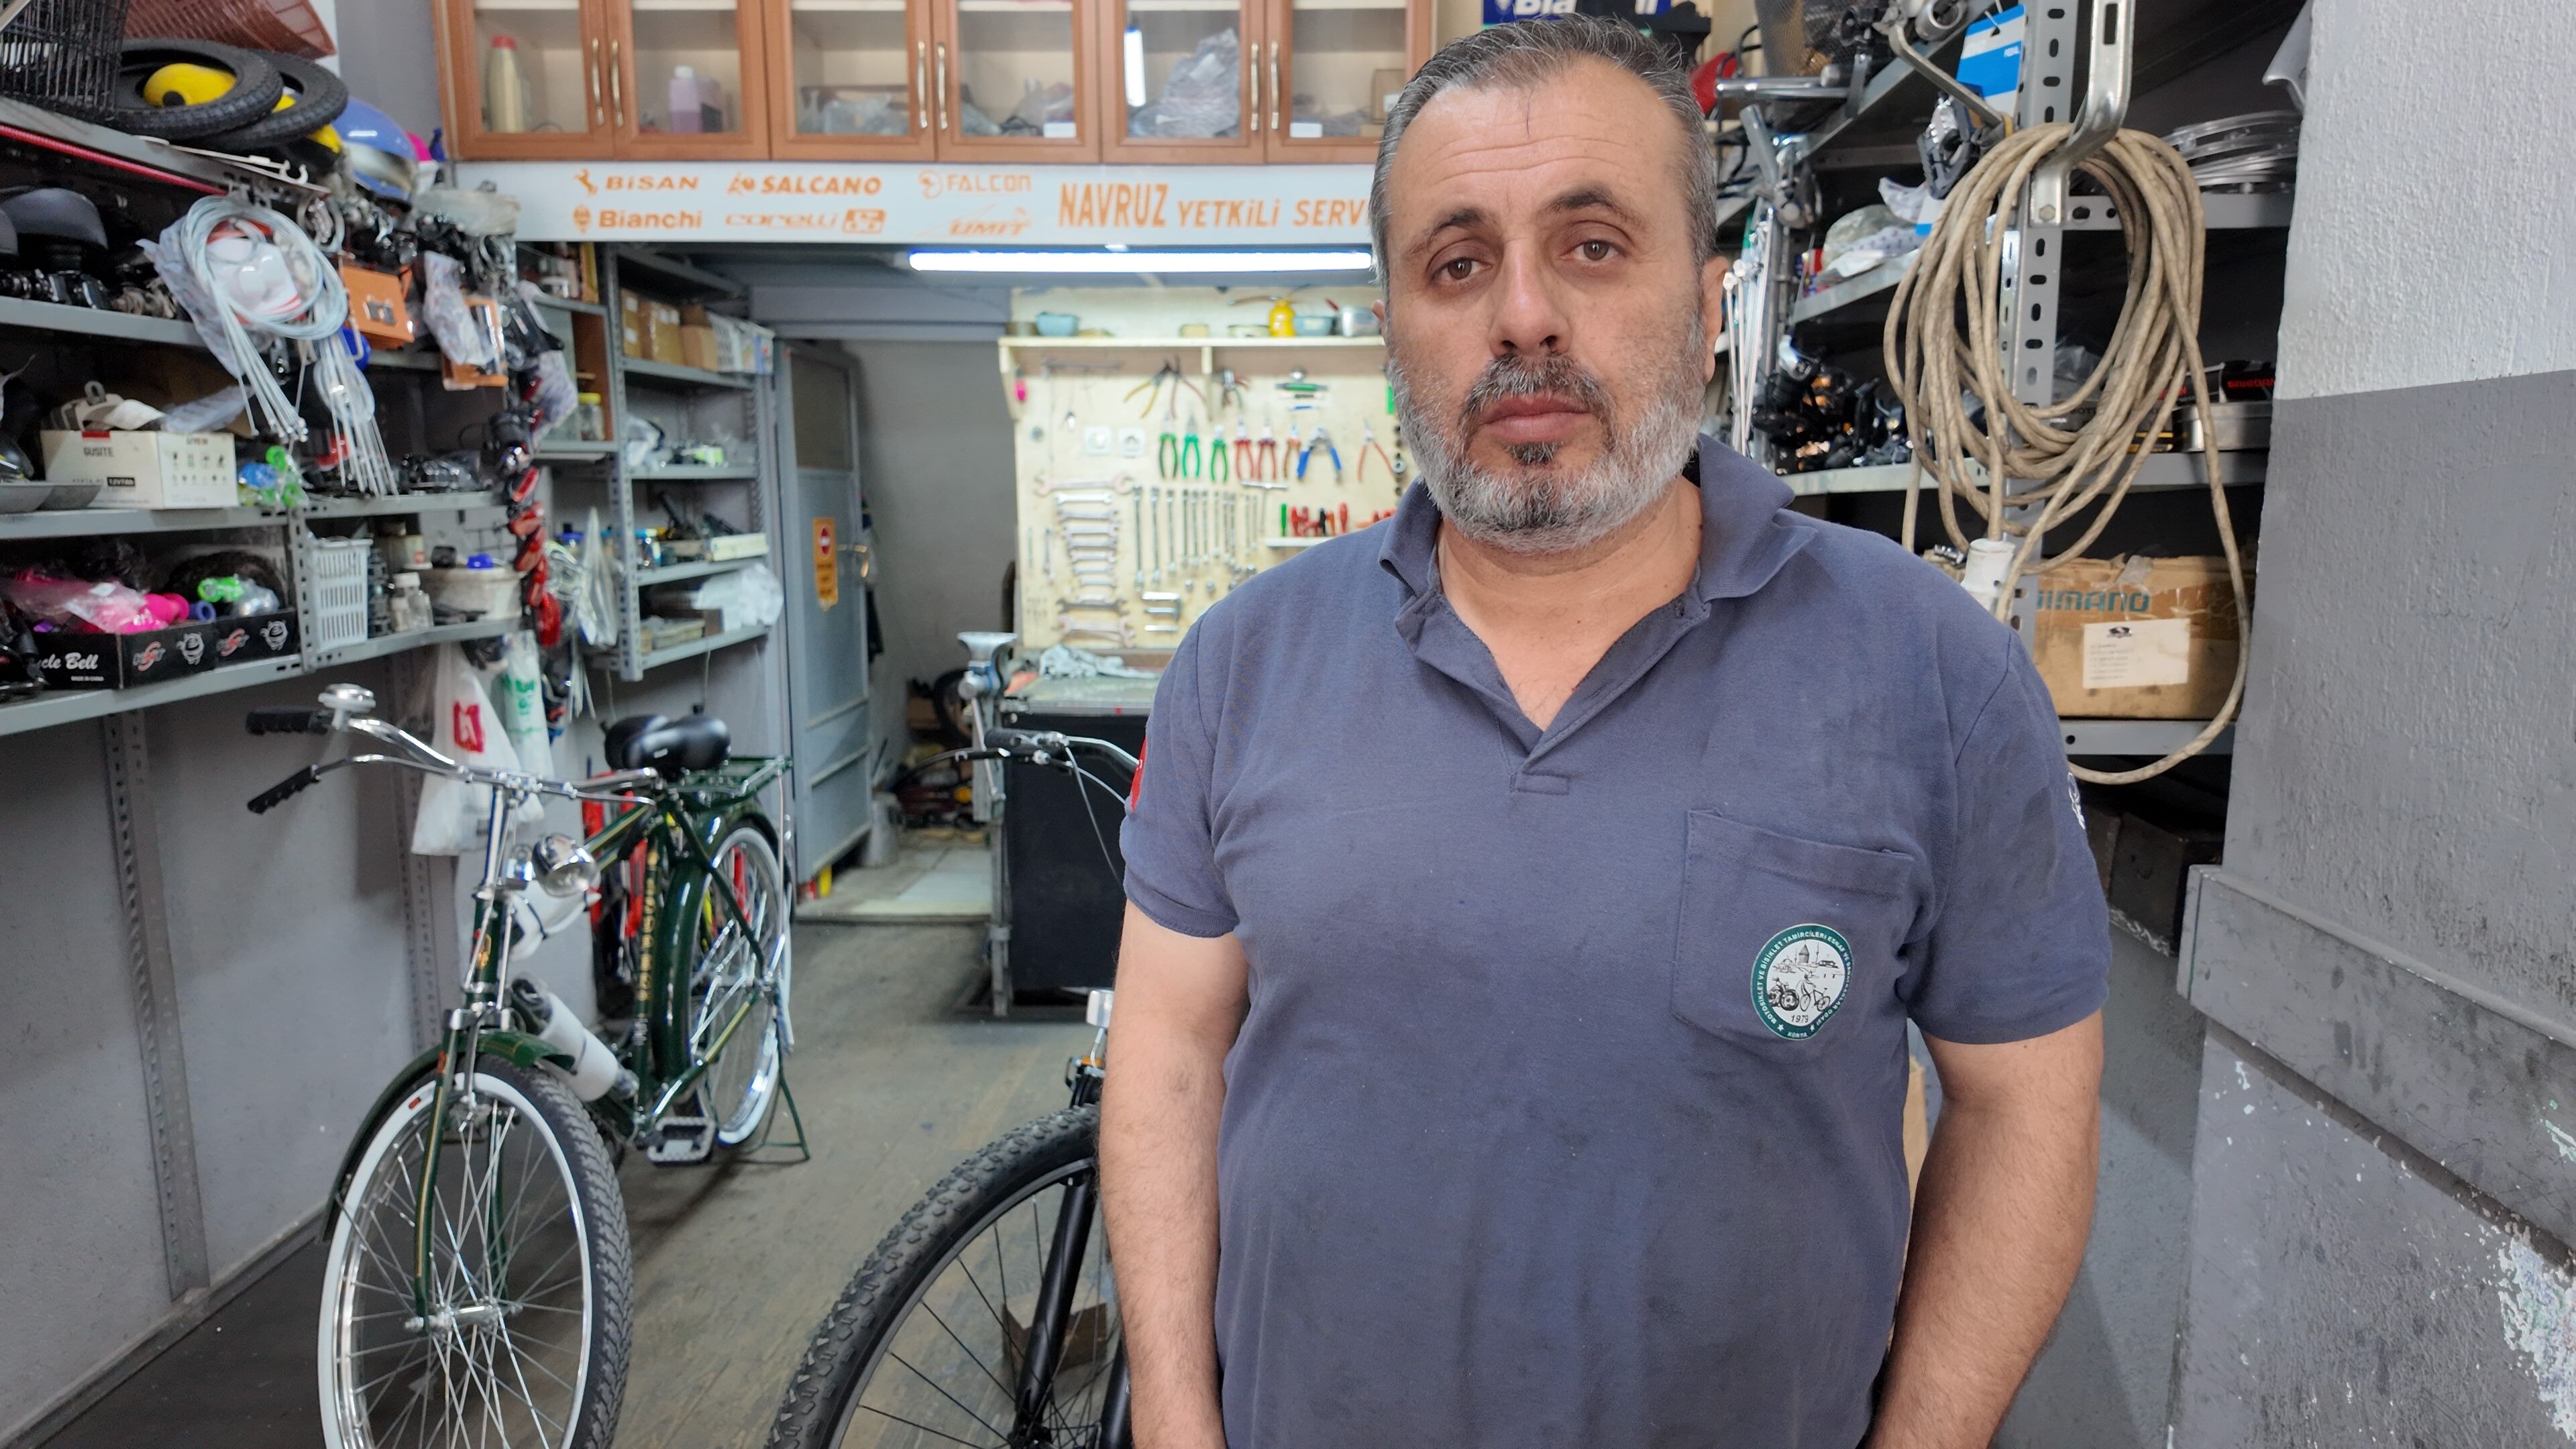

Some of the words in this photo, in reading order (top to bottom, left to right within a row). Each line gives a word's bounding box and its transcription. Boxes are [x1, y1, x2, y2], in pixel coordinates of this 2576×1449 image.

[761, 175, 883, 196] SALCANO
[947, 174, 1032, 193] FALCON
[1058, 182, 1169, 227] NAVRUZ
[1293, 199, 1369, 227] SERV
[599, 209, 703, 229] Bianchi
[65, 652, 99, 669] Bell
[1791, 1014, 1809, 1023] 1979
